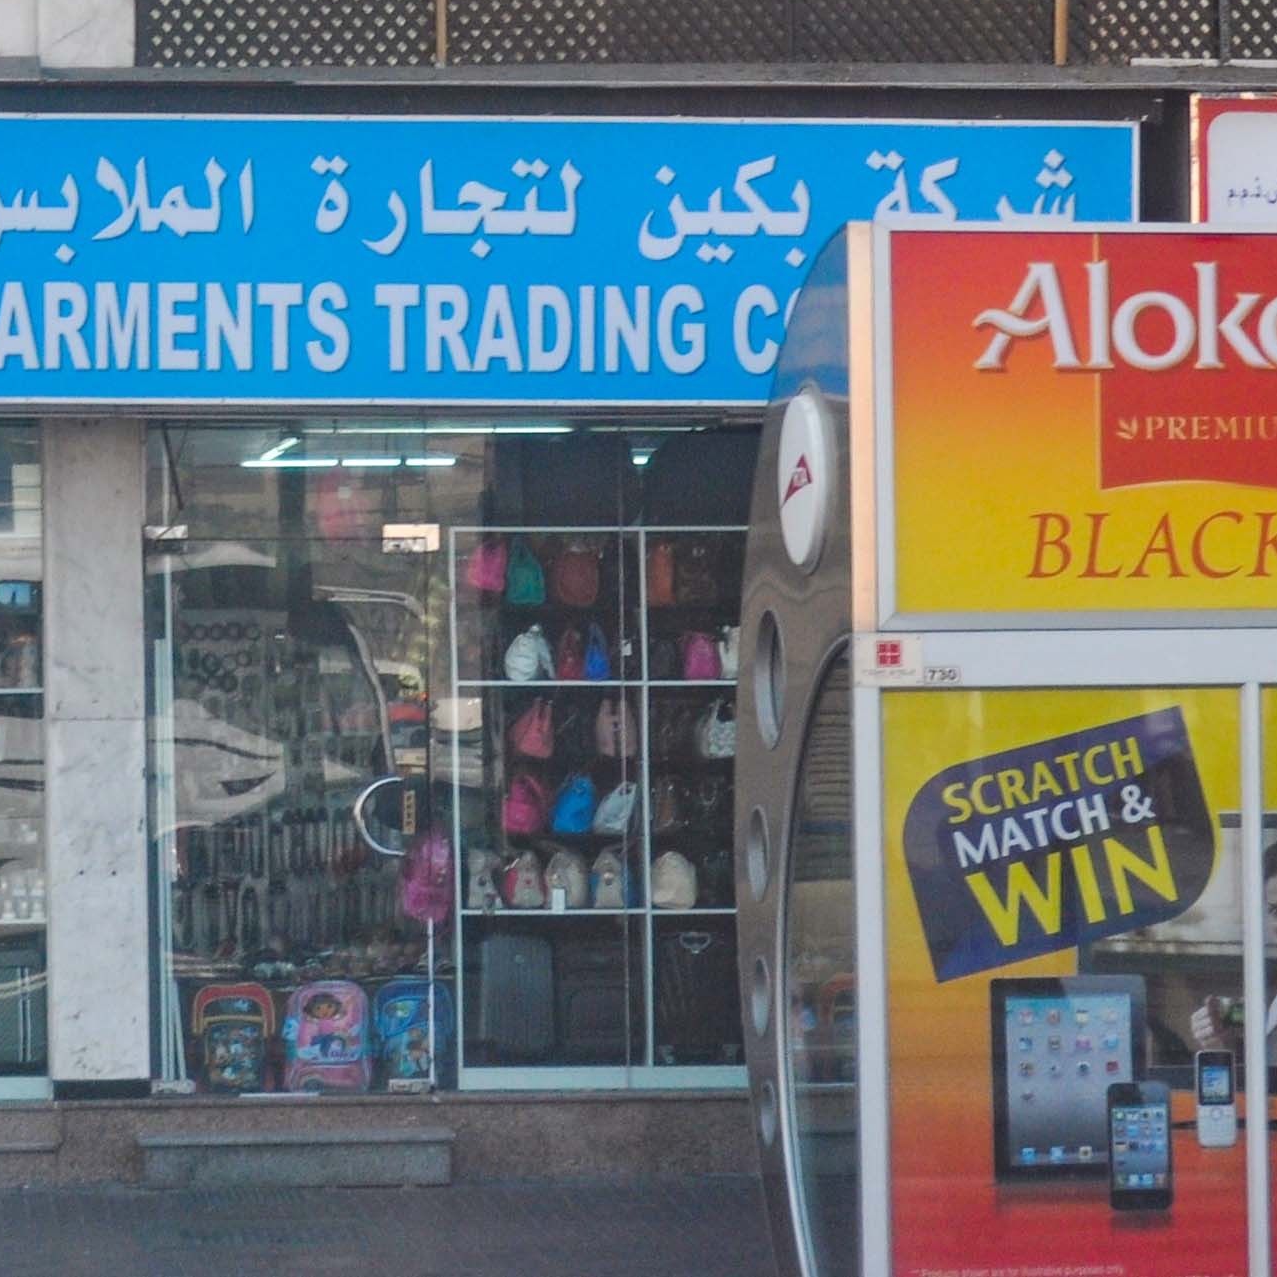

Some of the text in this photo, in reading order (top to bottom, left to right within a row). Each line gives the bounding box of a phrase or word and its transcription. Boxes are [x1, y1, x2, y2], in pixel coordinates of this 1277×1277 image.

[311, 155, 582, 258] لتجارة
[639, 155, 810, 267] بكين
[375, 283, 706, 374] TRADING
[734, 283, 801, 374] C
[941, 736, 1144, 824] SCRATCH
[953, 784, 1157, 869] MATCH &
[964, 824, 1179, 947] WIN
